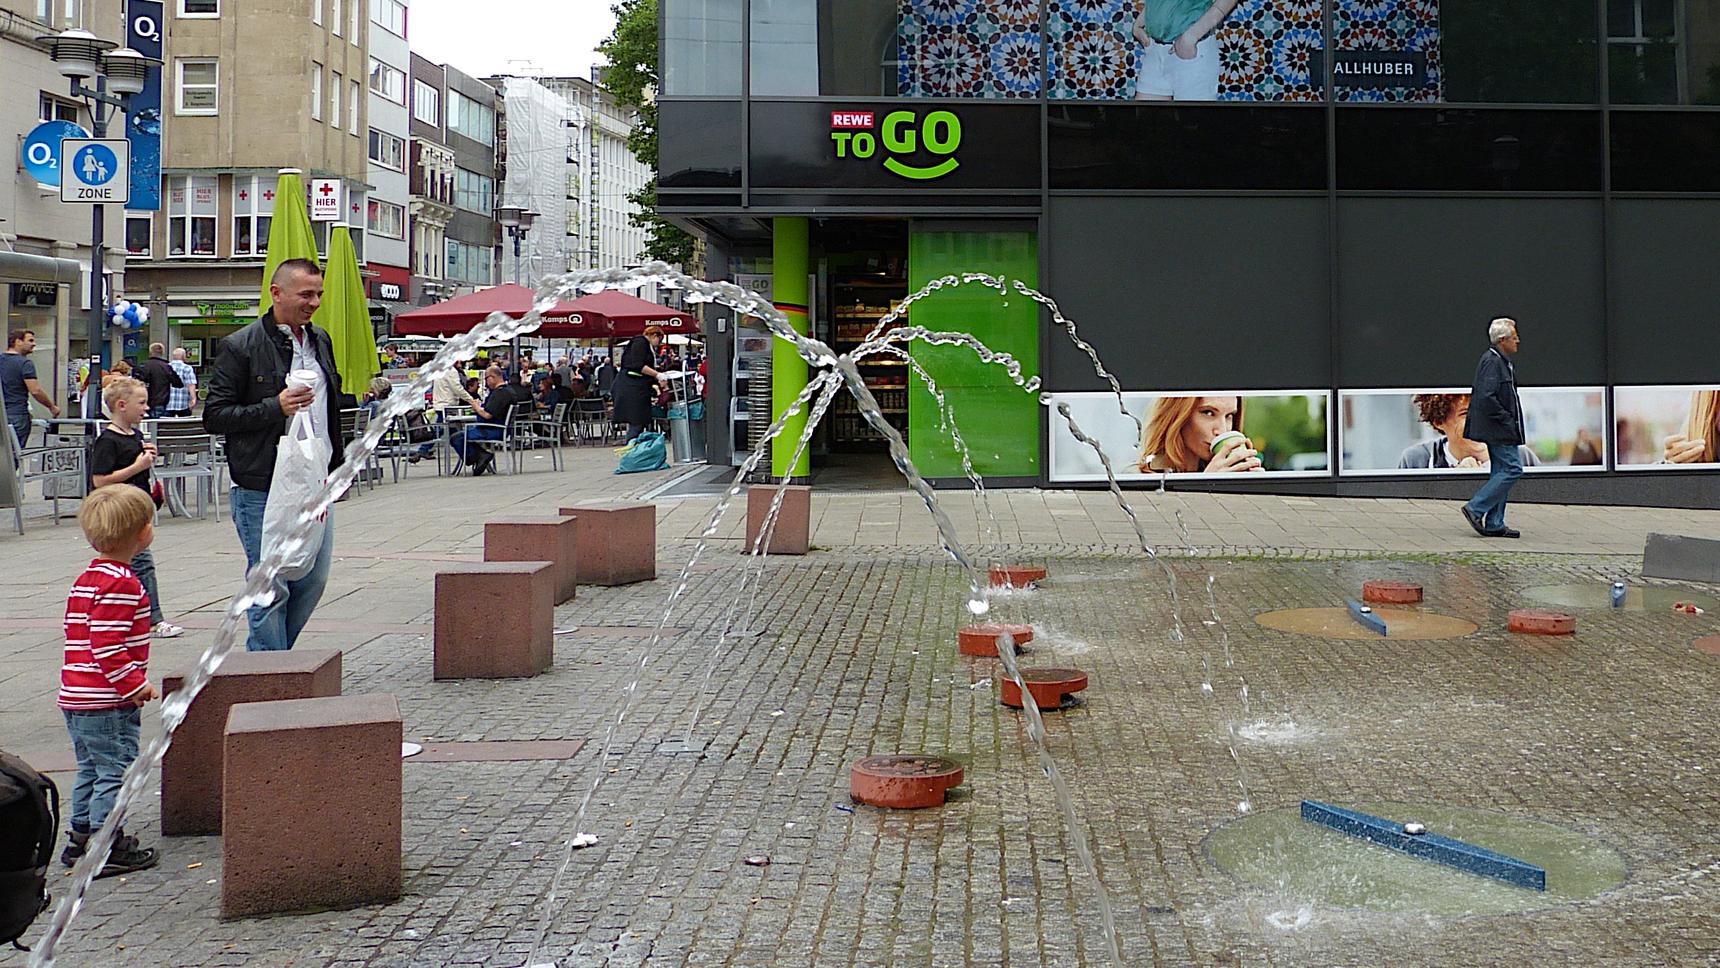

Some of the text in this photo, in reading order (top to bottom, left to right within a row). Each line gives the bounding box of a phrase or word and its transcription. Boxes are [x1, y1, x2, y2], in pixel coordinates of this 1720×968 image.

[1333, 61, 1414, 75] ALLHUBER
[833, 114, 872, 126] REWE
[831, 110, 962, 158] TO GO
[78, 188, 112, 199] ZONE
[316, 198, 336, 206] HIER
